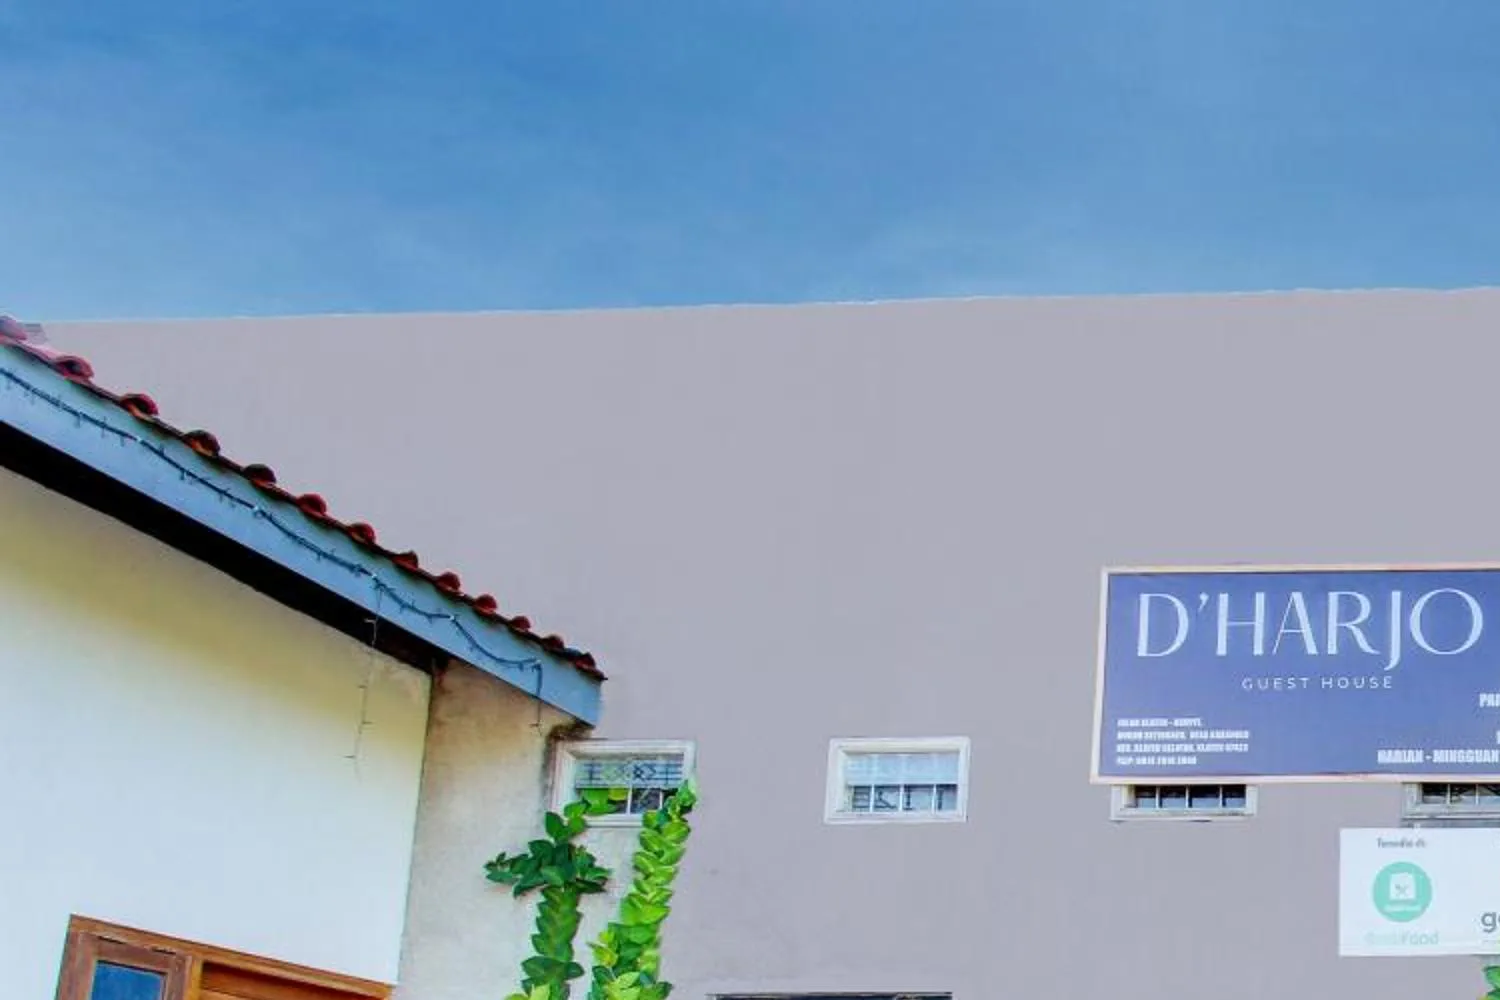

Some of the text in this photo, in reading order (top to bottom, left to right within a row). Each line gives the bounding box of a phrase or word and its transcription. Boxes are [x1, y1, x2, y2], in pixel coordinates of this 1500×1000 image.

[1137, 588, 1484, 671] D'HARJO
[1241, 676, 1393, 690] GUEST HOUSE
